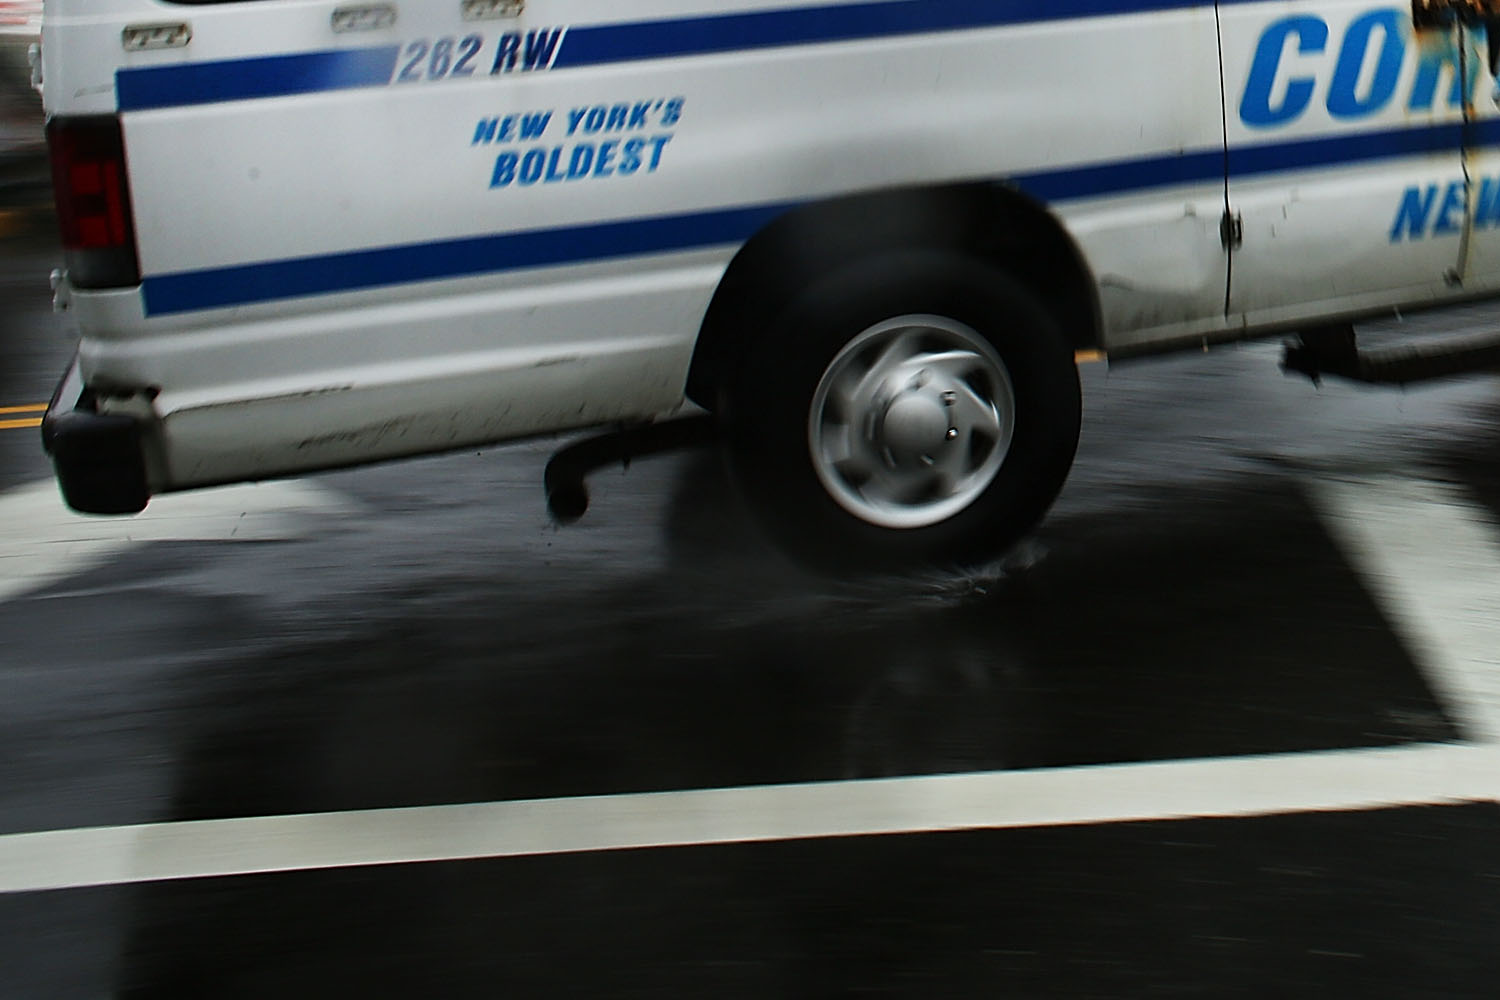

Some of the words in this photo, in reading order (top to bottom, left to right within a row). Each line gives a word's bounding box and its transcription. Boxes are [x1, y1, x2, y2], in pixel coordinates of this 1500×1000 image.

[489, 27, 562, 75] RW
[471, 111, 552, 145] NEW
[567, 97, 685, 135] YORK'S
[489, 134, 672, 189] BOLDEST
